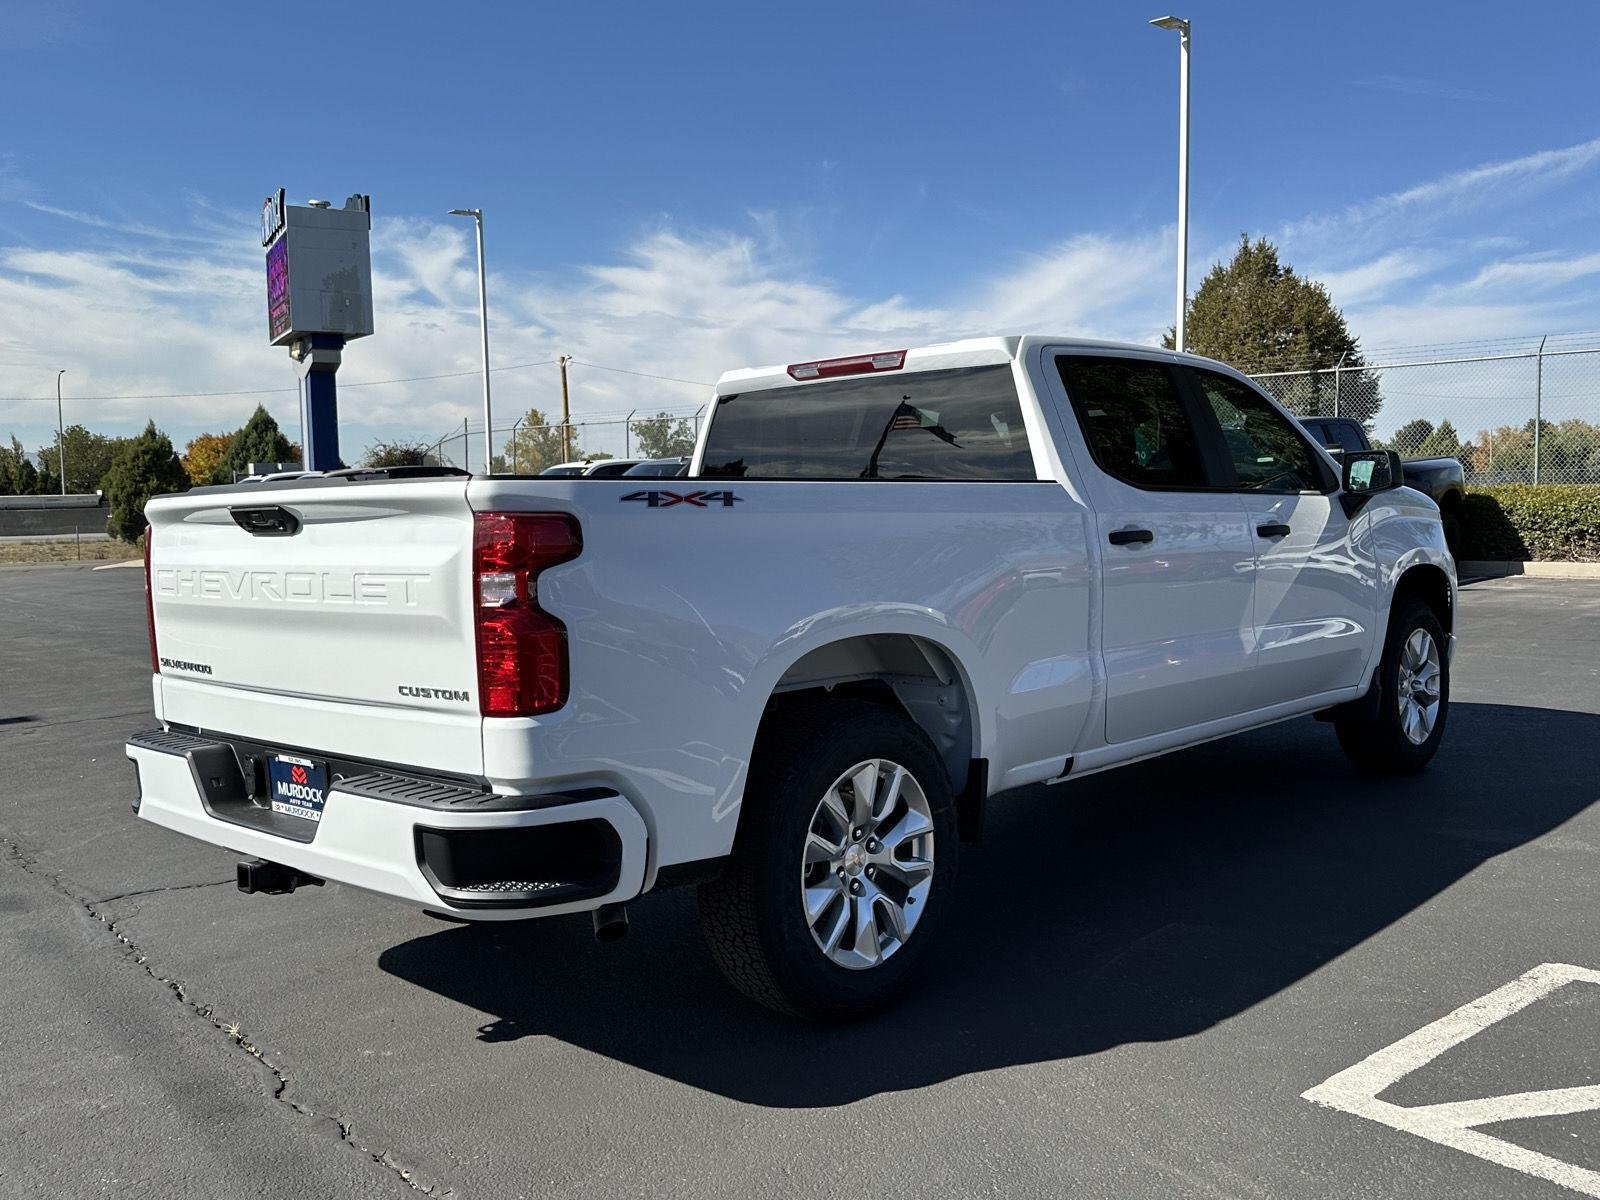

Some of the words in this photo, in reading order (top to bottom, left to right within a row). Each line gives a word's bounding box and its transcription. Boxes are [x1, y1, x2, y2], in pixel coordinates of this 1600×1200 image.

[156, 569, 431, 606] CHEVROLET
[160, 657, 213, 675] SILVERADO
[398, 685, 470, 702] CUSTOM
[277, 781, 324, 804] MURDOCK
[284, 806, 315, 819] MURDOCK
